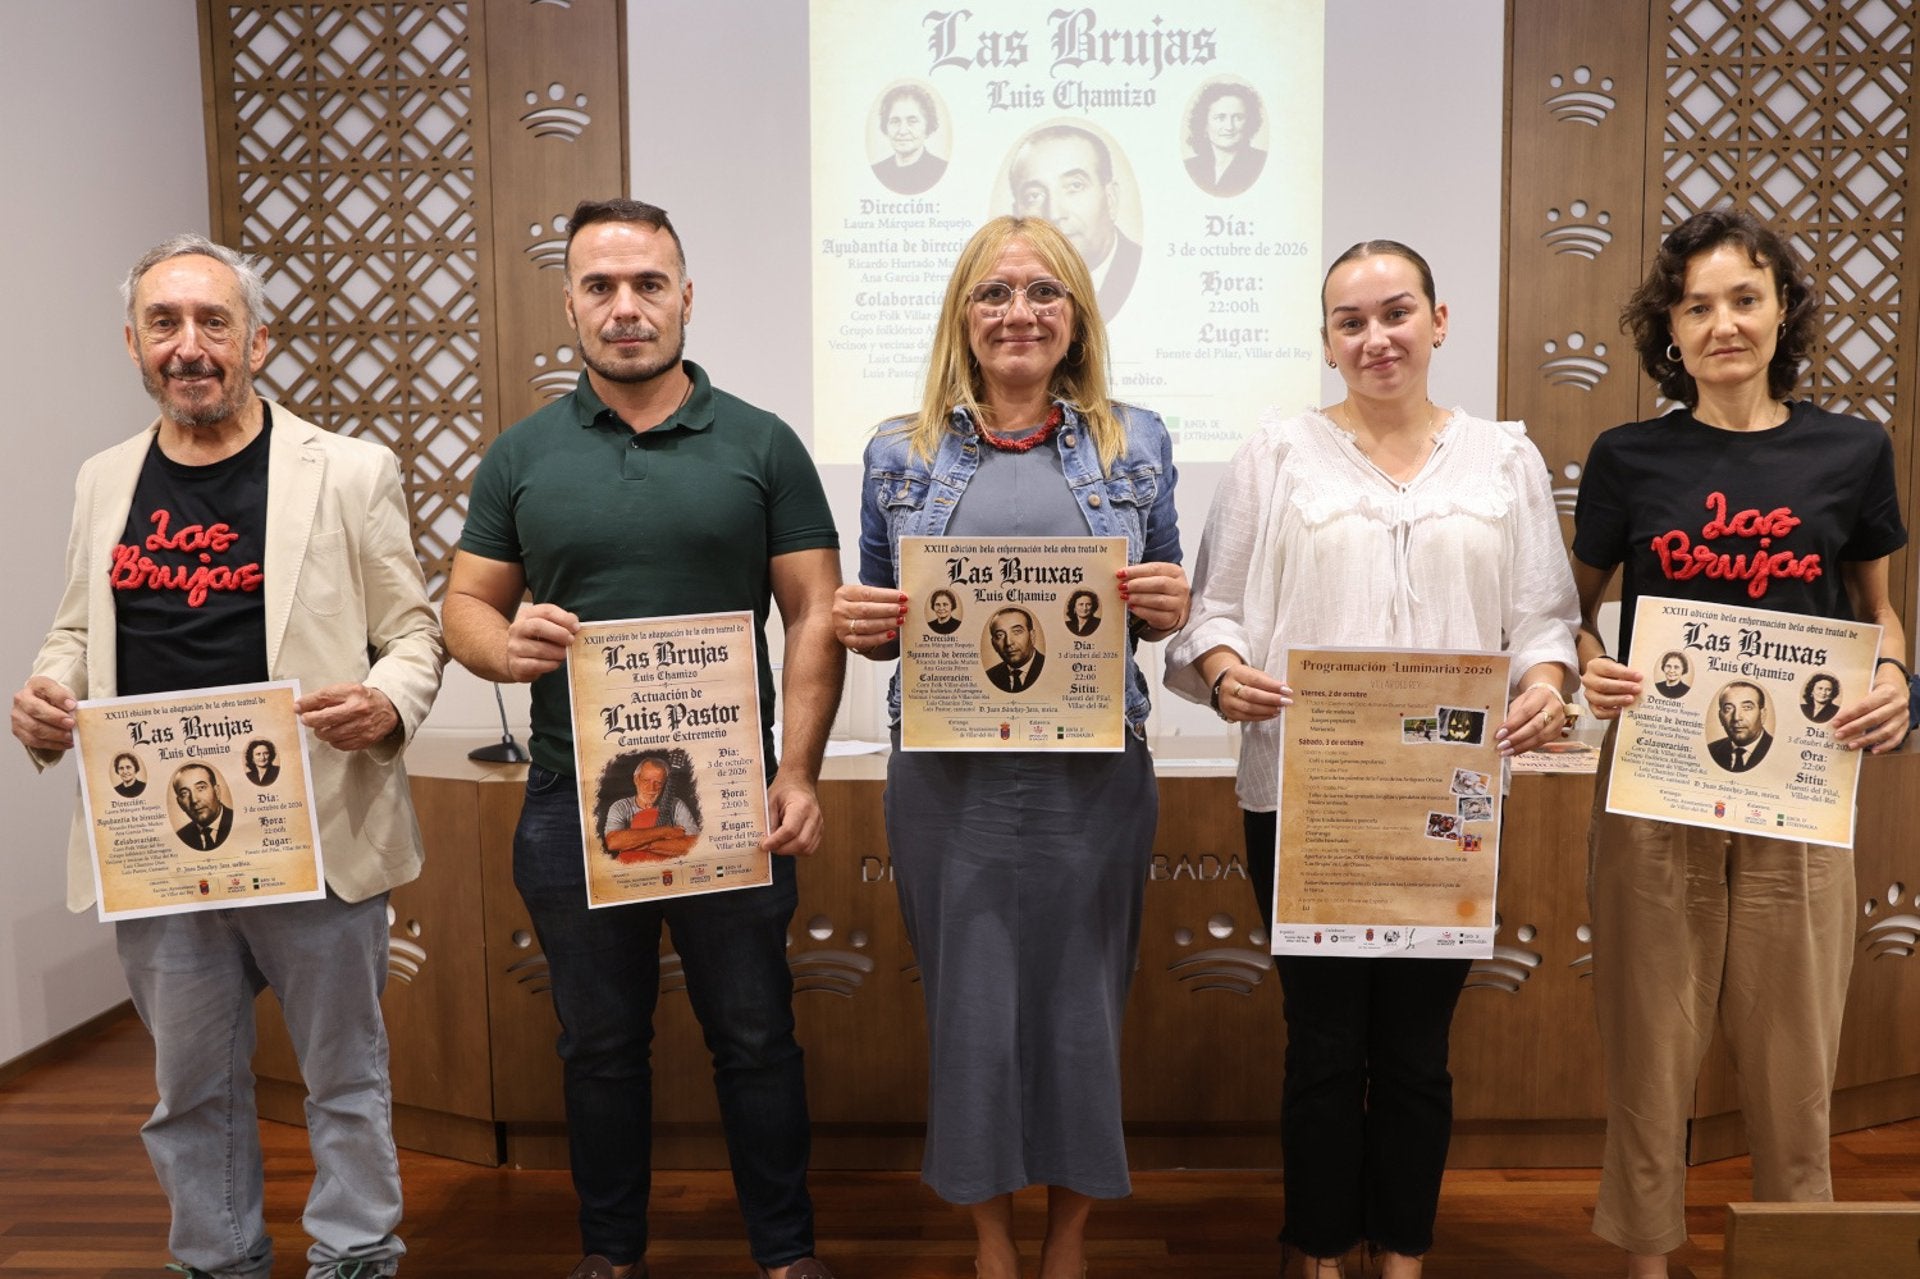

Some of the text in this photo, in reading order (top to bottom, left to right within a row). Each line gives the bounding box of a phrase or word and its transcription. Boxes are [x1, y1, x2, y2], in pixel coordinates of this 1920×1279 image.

[922, 7, 1217, 81] Las Brujas
[986, 80, 1157, 115] Luis Chamizo
[859, 198, 940, 215] Dirección:
[844, 217, 974, 232] Laura Márquez Requejo.
[1204, 214, 1255, 238] Día:
[822, 238, 965, 258] Ayudantía de direcci
[1167, 241, 1309, 257] 3 de octubre de 2026
[848, 258, 935, 269] Ricardo Hurtado
[861, 272, 882, 283] Ana
[924, 272, 950, 283] Pére
[1199, 270, 1263, 296] Hora:
[855, 291, 945, 307] Colaboració
[1208, 297, 1260, 313] 22:00h
[850, 310, 931, 321] Coro Folk Villar
[839, 325, 873, 338] Grupo
[1197, 322, 1269, 348] Lugar:
[828, 340, 867, 351] Vecinos
[877, 341, 915, 350] vecinas
[1155, 347, 1313, 361] Fuente del Pilar, Villar del Rey
[1121, 373, 1168, 386] médico.
[1183, 419, 1221, 429] JUNTA DE
[1183, 431, 1243, 441] EXTREMADURA
[1702, 491, 1801, 540] Las
[145, 509, 239, 552] Las
[924, 545, 948, 553] XXIII
[1651, 530, 1823, 599] Brujas
[110, 544, 265, 609] Brujas
[945, 556, 1084, 589] Las Bruxas
[973, 588, 1058, 605] Luis Chamizo
[1662, 606, 1689, 617] XXIII
[1848, 630, 1858, 640] de
[584, 636, 605, 645] XXIII
[631, 632, 638, 640] de
[640, 631, 647, 640] la
[686, 628, 693, 637] de
[737, 624, 744, 633] de
[1683, 621, 1828, 667] Las Bruxas
[601, 640, 729, 676] Las Brujas
[1072, 662, 1097, 673] Ora:
[1299, 659, 1493, 676] Programación Luminarias 2026
[1707, 656, 1795, 682] Luis Chamizo
[632, 669, 698, 683] Luis Chamizo
[1074, 673, 1097, 681] 22:00
[1069, 683, 1099, 694] Sitiu:
[1301, 689, 1327, 698] Viernes,
[1333, 689, 1342, 698] de
[1342, 690, 1368, 699] octubre
[630, 688, 703, 705] Actuación de
[105, 711, 129, 720] XXIII
[600, 702, 741, 741] Luis Pastor
[127, 715, 254, 749] Las Brujas
[617, 728, 727, 747] Cantautor Extremeño
[1330, 738, 1339, 747] de
[1340, 738, 1364, 747] octubre
[158, 743, 231, 762] Luis Chamizo
[1800, 749, 1828, 763] Ora:
[707, 757, 753, 769] 3 de octubre
[1802, 762, 1826, 772] 22:00
[717, 768, 747, 777] de 2026
[1794, 772, 1828, 787] Sitiu:
[720, 789, 748, 800] Hora:
[258, 815, 287, 828] Hora:
[721, 820, 754, 832] Lugar:
[262, 837, 293, 848] Lugar:
[709, 832, 746, 843] Fuente del
